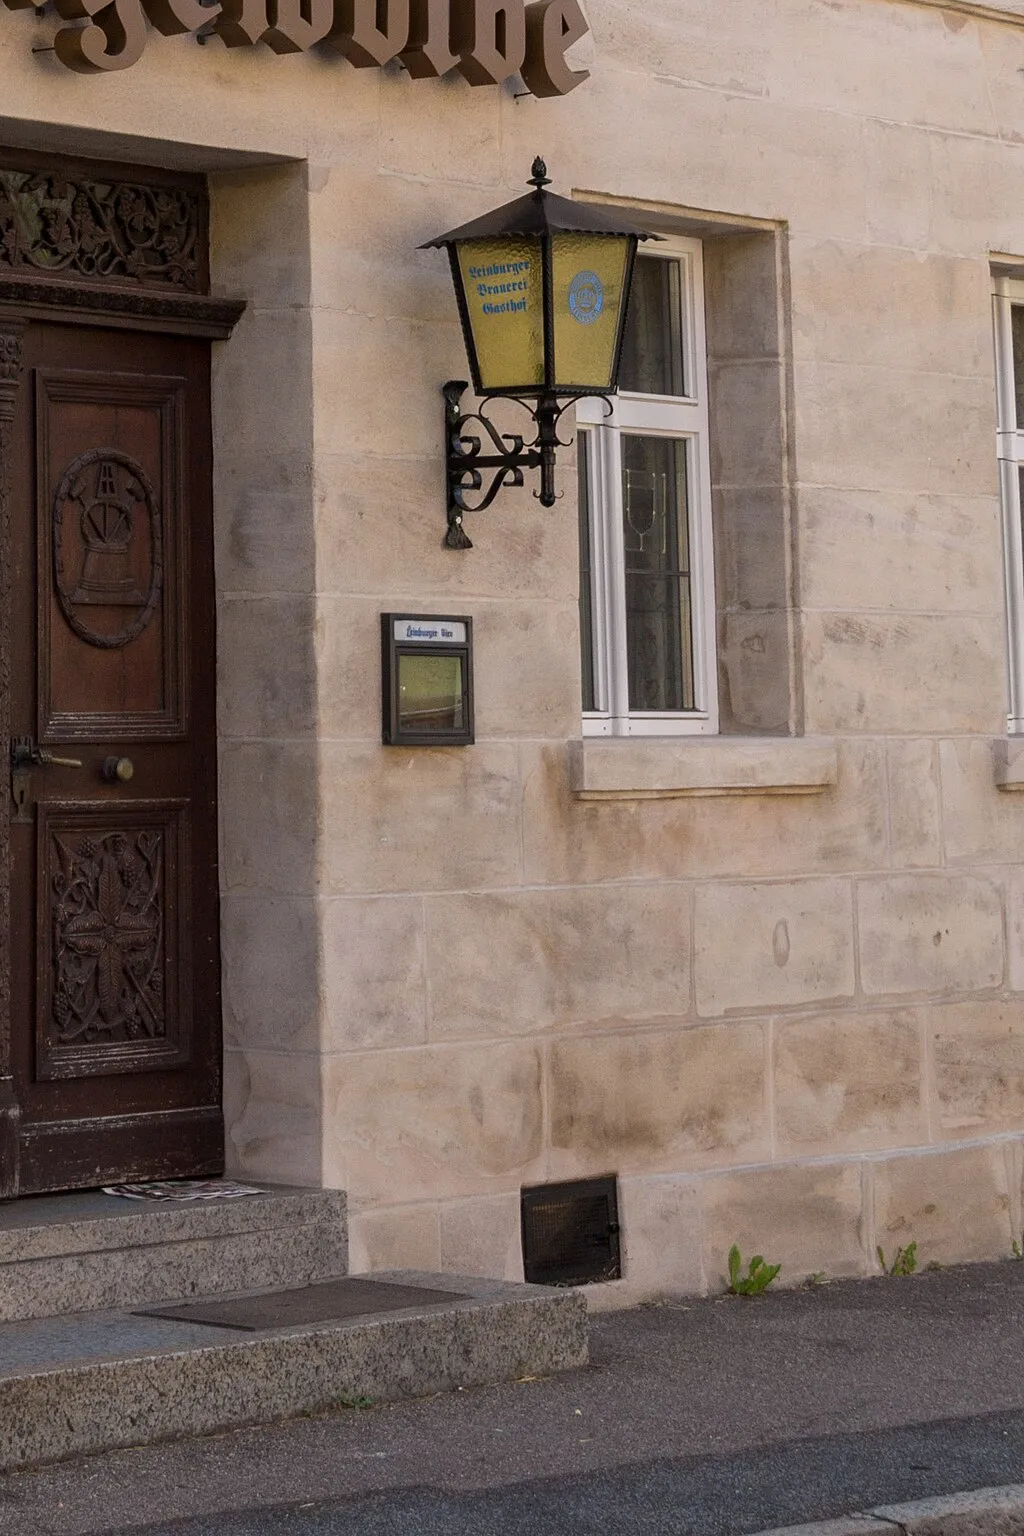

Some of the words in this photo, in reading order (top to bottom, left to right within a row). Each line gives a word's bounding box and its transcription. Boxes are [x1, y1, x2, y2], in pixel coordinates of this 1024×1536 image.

[469, 260, 530, 279] Leinburger
[477, 277, 528, 296] Brauerei
[482, 296, 527, 315] Gasthof
